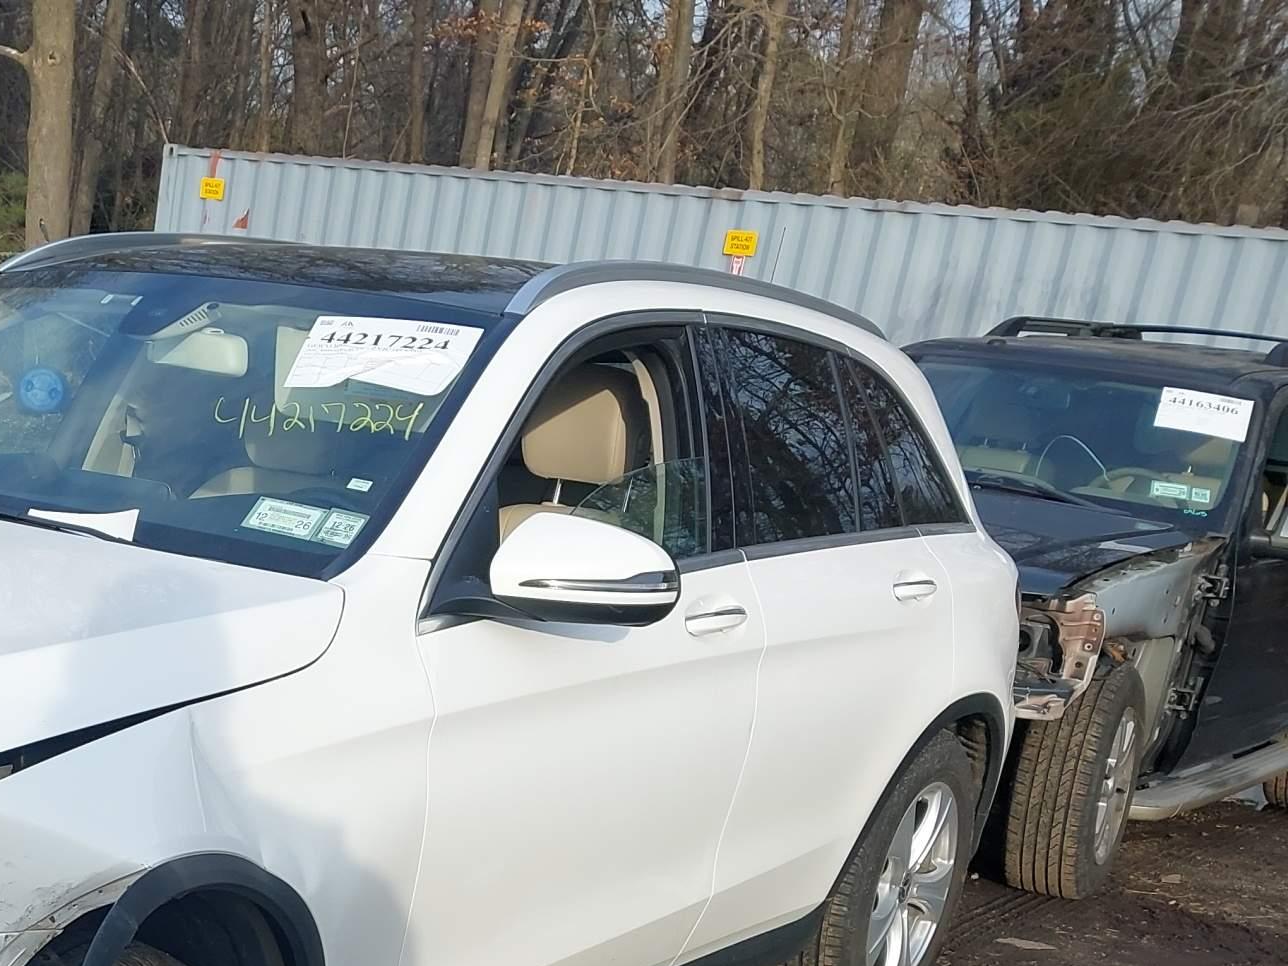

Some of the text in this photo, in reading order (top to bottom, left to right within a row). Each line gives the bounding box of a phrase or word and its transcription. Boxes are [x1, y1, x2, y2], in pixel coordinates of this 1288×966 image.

[320, 331, 451, 350] 44217224
[214, 396, 425, 441] 44217224
[255, 511, 269, 521] 12
[294, 520, 312, 530] 26
